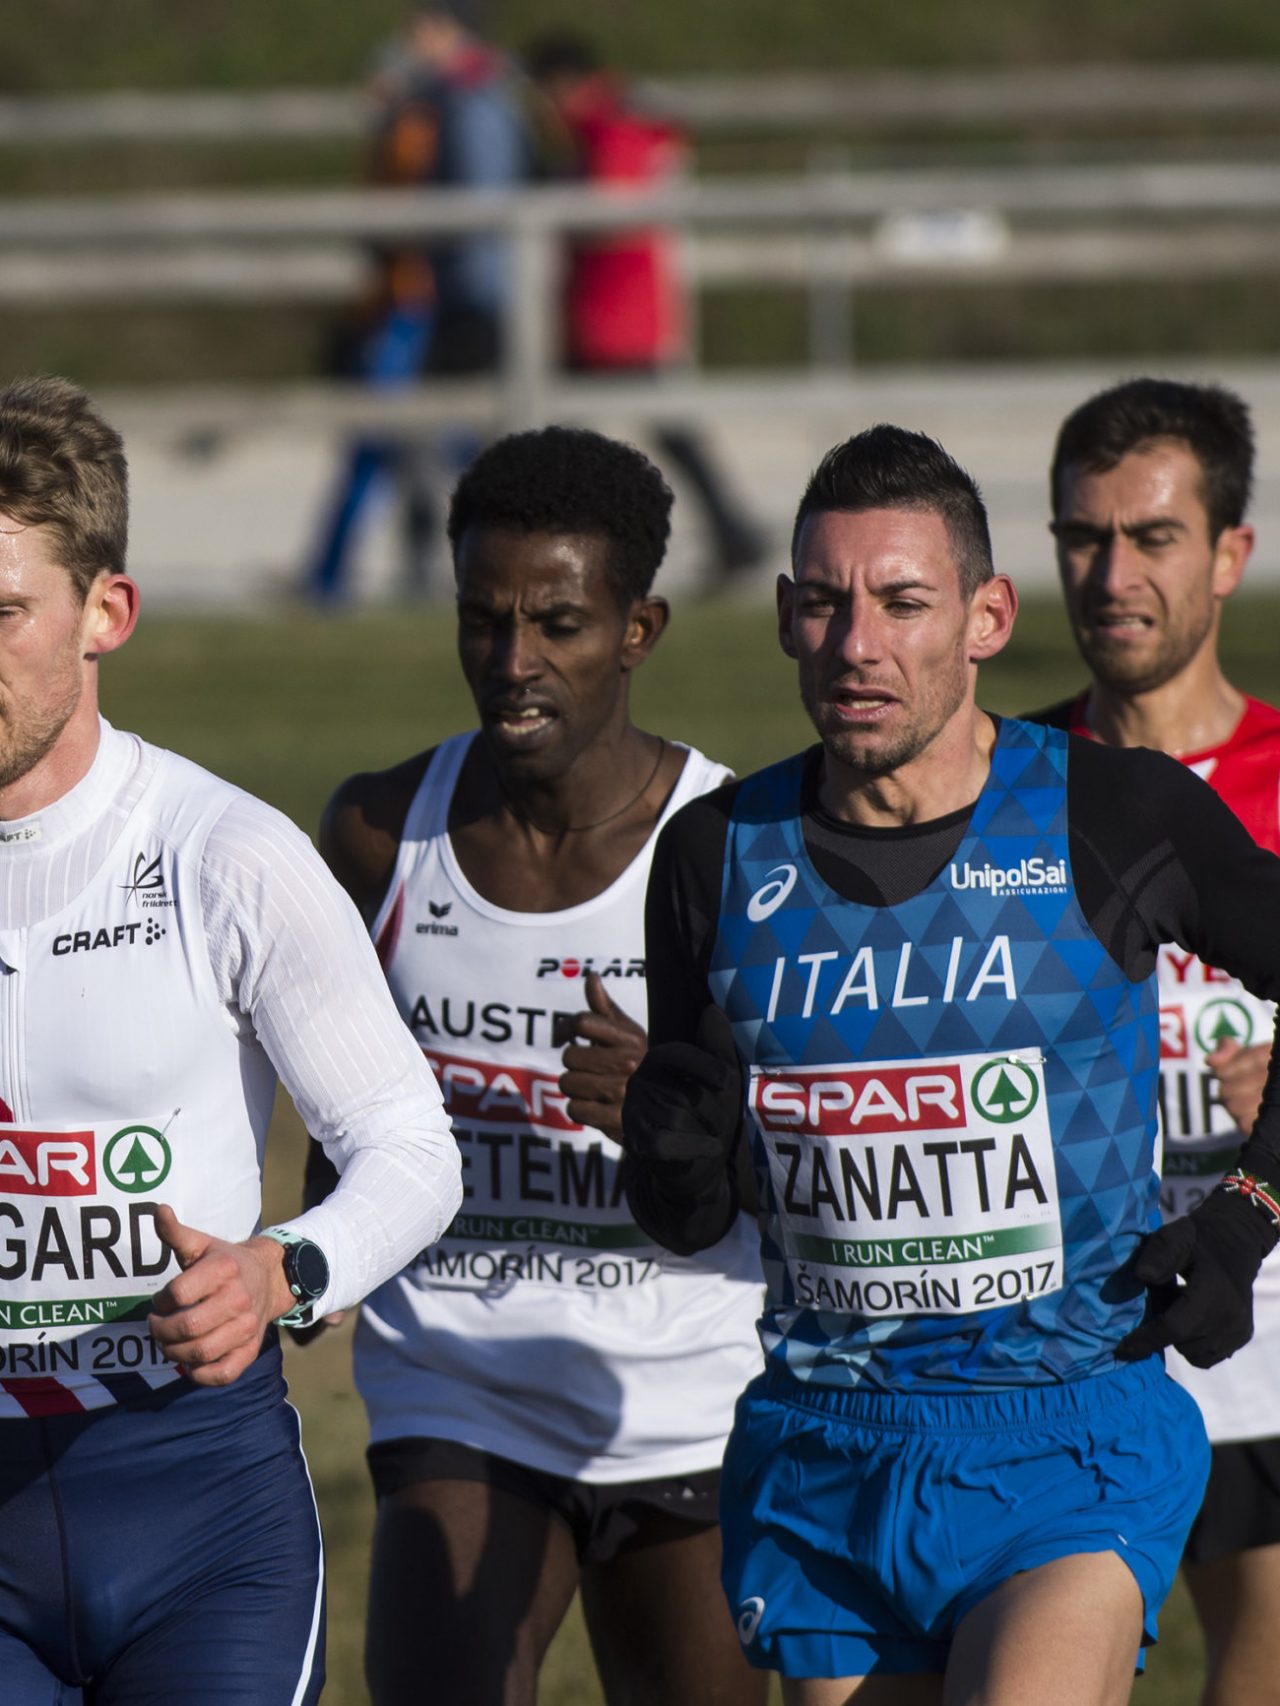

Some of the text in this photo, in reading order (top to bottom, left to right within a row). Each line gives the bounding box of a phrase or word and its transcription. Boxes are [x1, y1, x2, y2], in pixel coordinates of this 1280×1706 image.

[951, 857, 1066, 896] UnipolSai
[999, 887, 1067, 896] ASSICURAZIONI
[52, 922, 142, 956] CRAFT
[416, 922, 458, 937] erima
[536, 958, 645, 979] POLAR
[766, 935, 1018, 1022] ITALIA
[431, 1060, 576, 1126] PAR
[761, 1074, 959, 1127] SPAR
[775, 1133, 1049, 1222] ZANATTA
[453, 1217, 504, 1239] RUN
[411, 1245, 655, 1288] AMORÍN 2017
[832, 1242, 838, 1262] I
[844, 1243, 894, 1264] RUN
[797, 1260, 1056, 1311] ŠAMORÍN 2017
